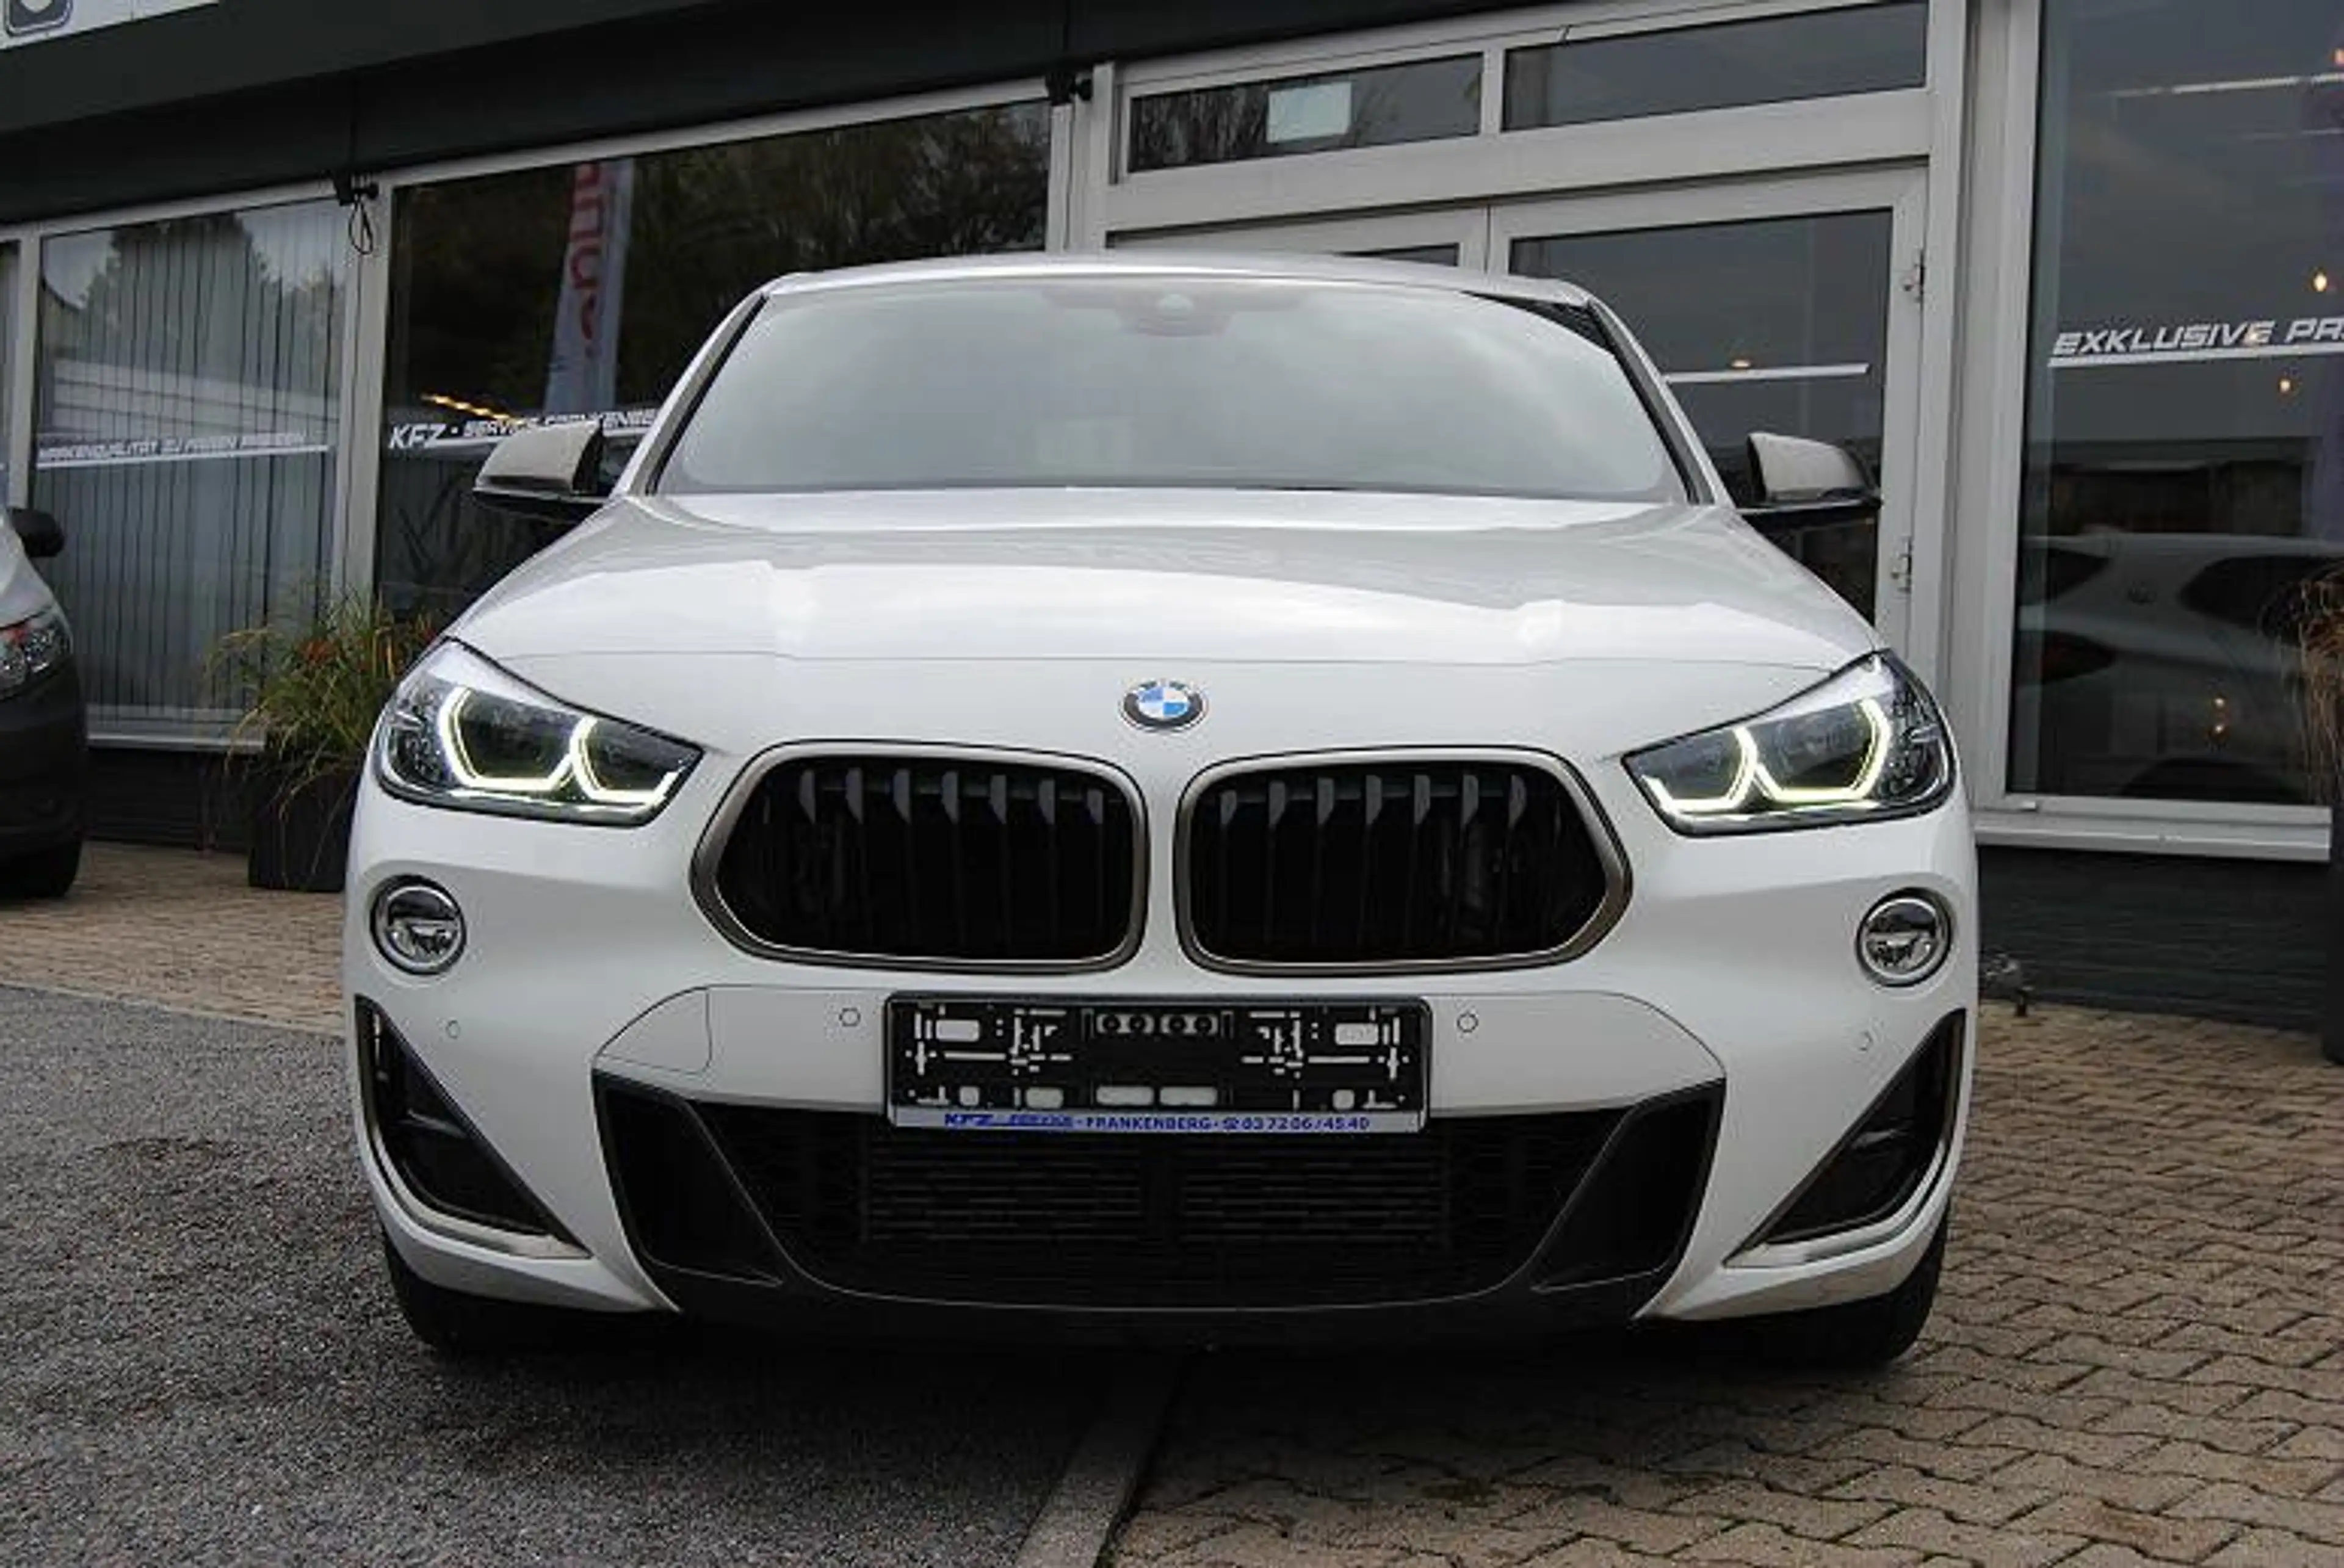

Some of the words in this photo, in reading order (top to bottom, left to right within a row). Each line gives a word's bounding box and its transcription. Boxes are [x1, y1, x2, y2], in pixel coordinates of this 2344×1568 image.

[2053, 320, 2276, 355] EXKLUSIVE
[2284, 317, 2344, 344] PA
[388, 423, 447, 449] KFZ
[1087, 1116, 1212, 1130] FRANKENBERG
